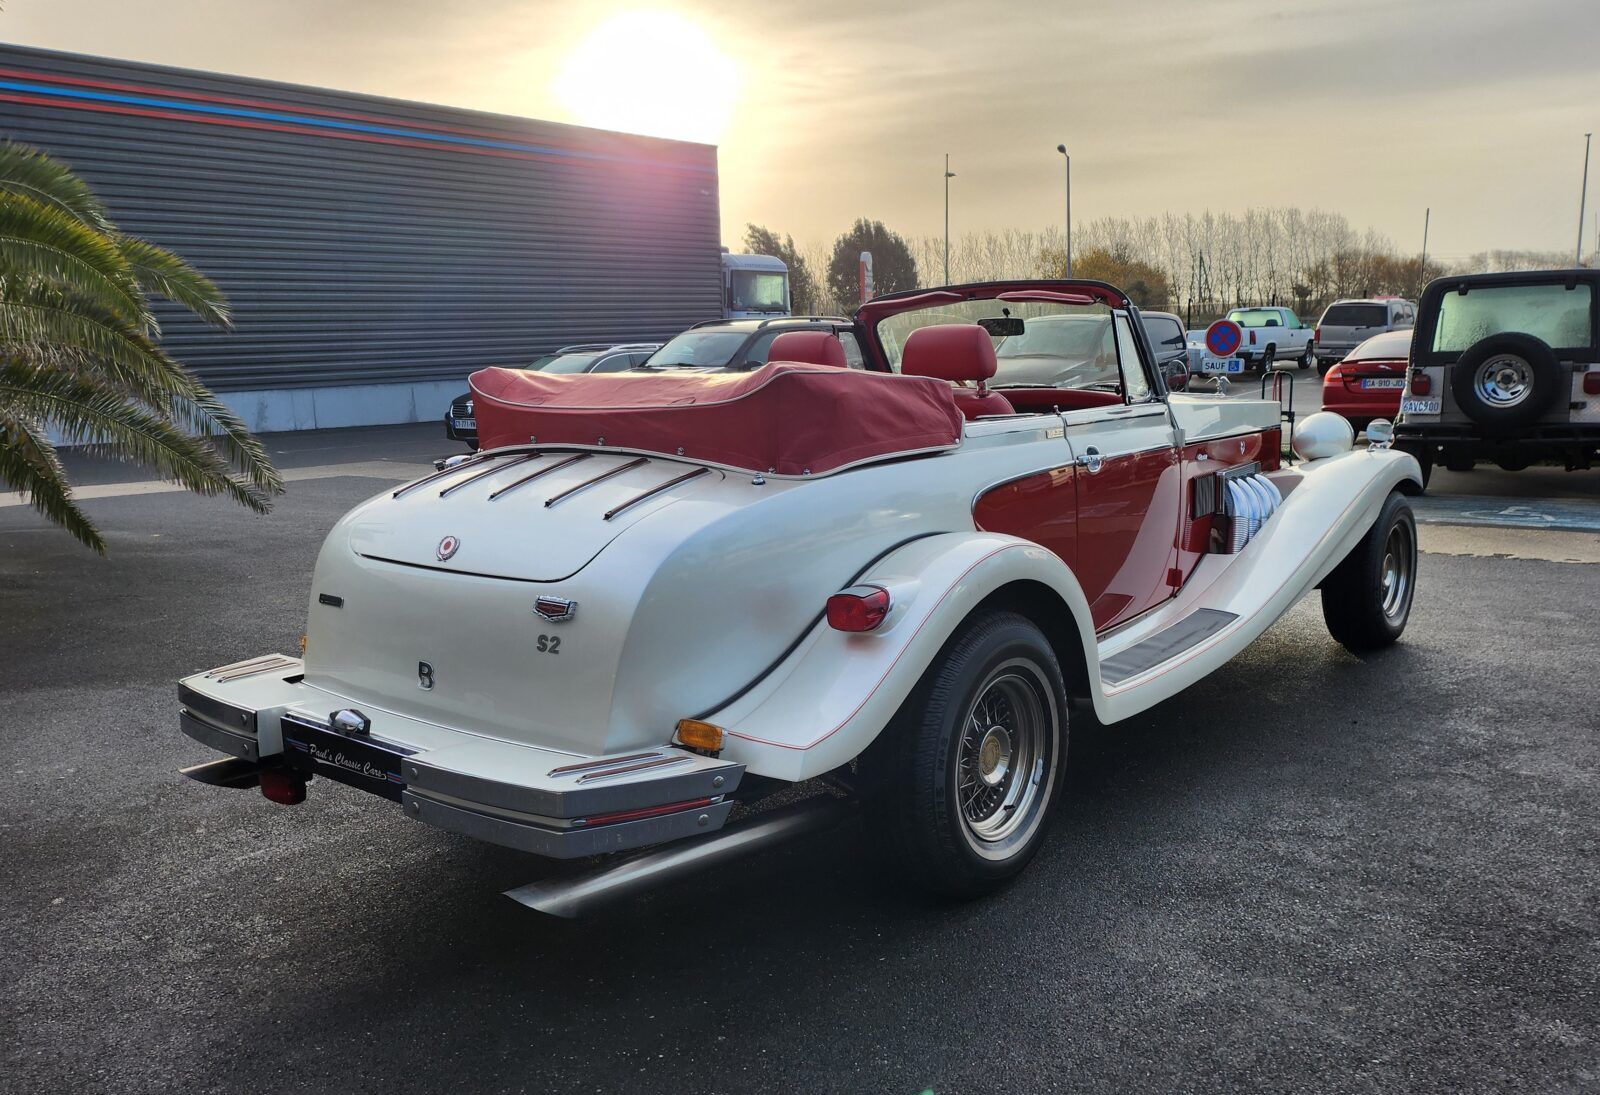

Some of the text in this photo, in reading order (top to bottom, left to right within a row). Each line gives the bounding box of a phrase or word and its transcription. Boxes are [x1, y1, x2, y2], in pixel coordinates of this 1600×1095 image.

[1205, 362, 1226, 370] SAUF
[537, 634, 561, 654] S2
[309, 743, 383, 777] Paul's Classic Cars
